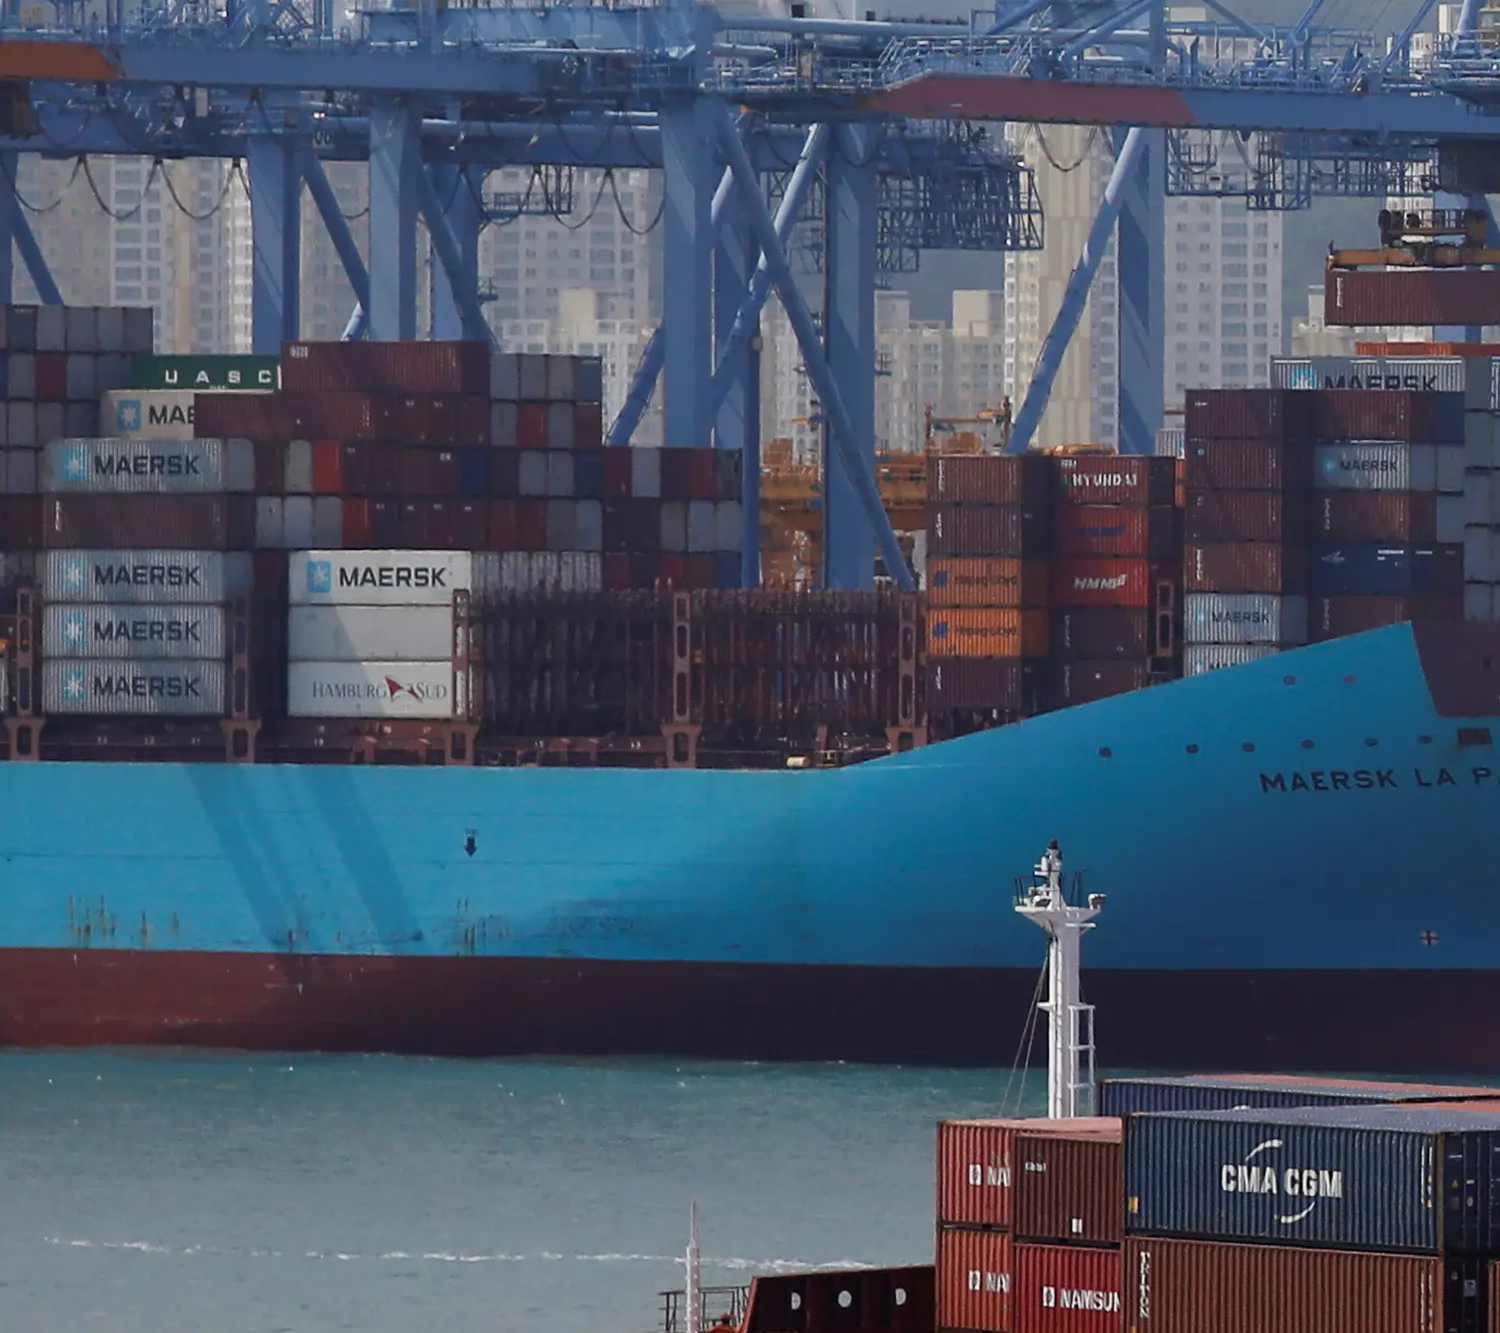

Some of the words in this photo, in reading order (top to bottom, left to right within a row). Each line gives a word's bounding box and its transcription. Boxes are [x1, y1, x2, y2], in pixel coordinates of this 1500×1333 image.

[94, 455, 200, 475] MAERSK
[1339, 460, 1398, 472] MAERSK
[1072, 473, 1138, 487] HYUNDAI
[93, 565, 200, 586] MAERSK
[339, 566, 447, 587] MAERSK
[93, 621, 200, 642] MAERSK
[93, 676, 200, 697] MAERSK
[312, 681, 388, 700] HAMBURG
[1259, 768, 1399, 794] MAERSK
[1413, 767, 1456, 788] LA
[1221, 1163, 1278, 1195] CMA
[1284, 1168, 1343, 1199] CGM
[1139, 1250, 1151, 1319] TRITON
